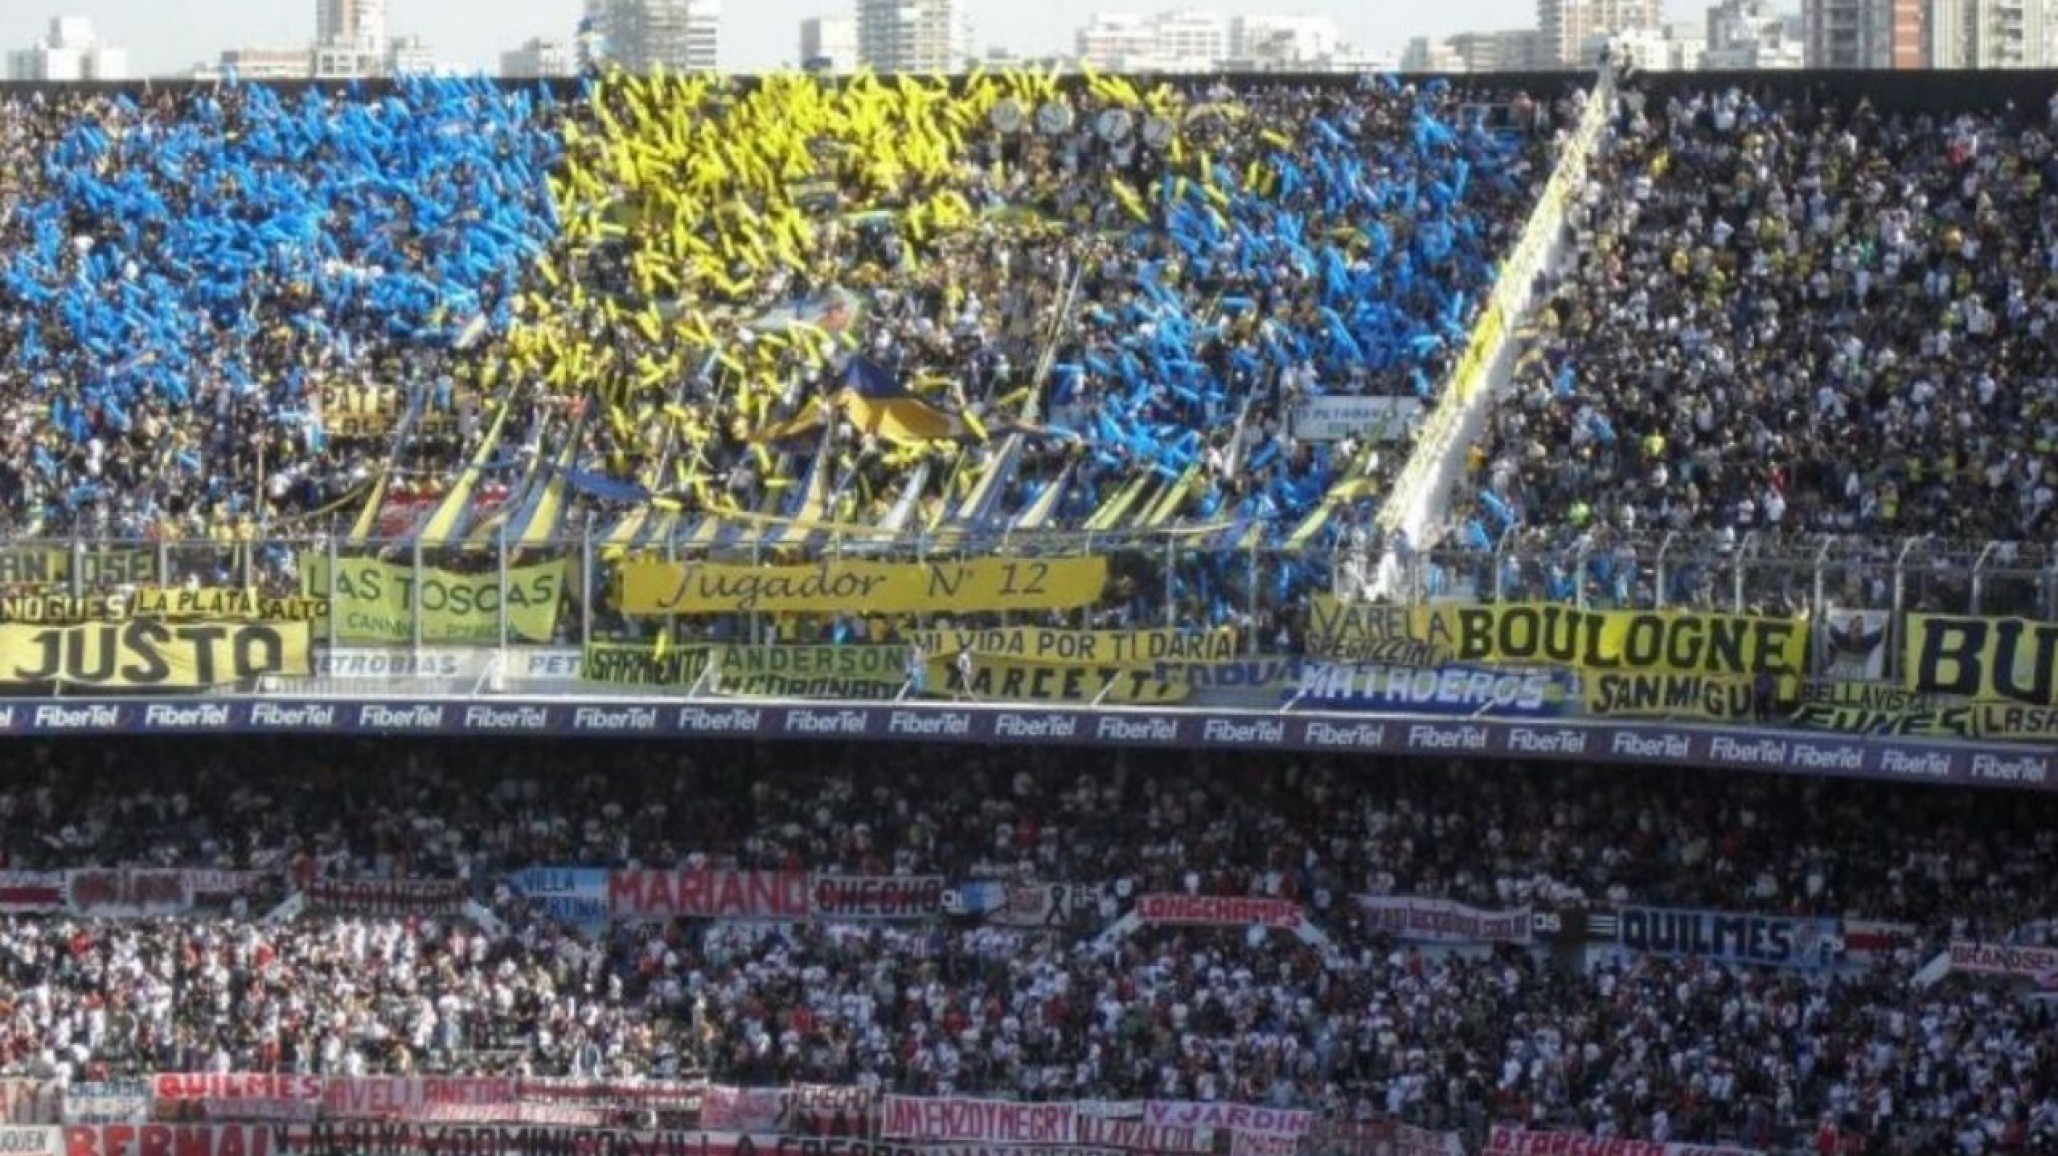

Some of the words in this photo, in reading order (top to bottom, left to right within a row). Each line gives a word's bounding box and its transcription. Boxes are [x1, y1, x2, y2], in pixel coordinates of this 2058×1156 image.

[307, 564, 383, 602] LAS
[393, 574, 555, 616] TOSCAS
[997, 560, 1049, 596] 12
[1037, 634, 1097, 660] POR
[1459, 608, 1794, 674] BOULOGNE
[13, 616, 284, 691] JUSTO
[34, 706, 118, 726] FiberTel
[145, 706, 229, 726] FiberTel
[250, 705, 334, 725] FiberTel
[359, 705, 442, 727] FiberTel
[464, 706, 547, 728] FiberTel
[573, 707, 657, 729] FiberTel
[678, 708, 760, 731] FiberTel
[785, 711, 867, 732] FiberTel
[889, 711, 969, 734] FiberTel
[994, 713, 1076, 736] FiberTel
[1097, 718, 1178, 740] FiberTel
[1204, 719, 1284, 742] FiberTel
[1305, 722, 1384, 746] FiberTel
[1409, 726, 1488, 749] FiberTel
[1508, 728, 1587, 752] FiberTel
[1611, 732, 1690, 757] FiberTel
[1709, 736, 1786, 764] FiberTel
[1791, 744, 1863, 769] FiberTel
[1881, 748, 1950, 776] FiberTel
[1971, 753, 2046, 783] FiberTel
[1622, 909, 1794, 961] QUILMES
[157, 1074, 320, 1098] QUILMES
